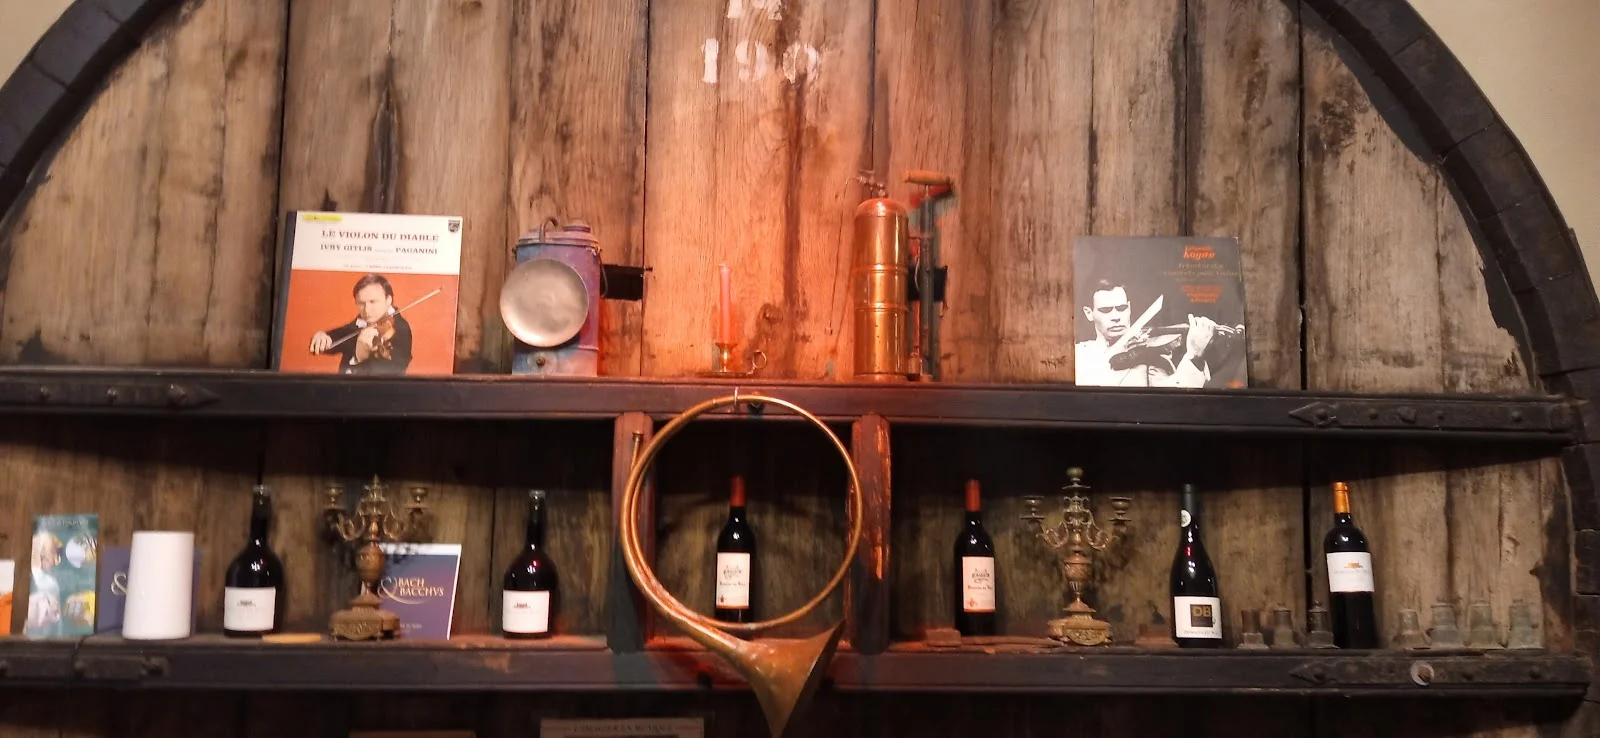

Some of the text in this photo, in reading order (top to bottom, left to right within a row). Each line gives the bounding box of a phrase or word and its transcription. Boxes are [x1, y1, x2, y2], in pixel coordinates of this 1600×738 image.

[322, 230, 439, 242] LE VIOLON DU DIABLE
[398, 577, 425, 587] BACH
[1192, 605, 1211, 617] DB
